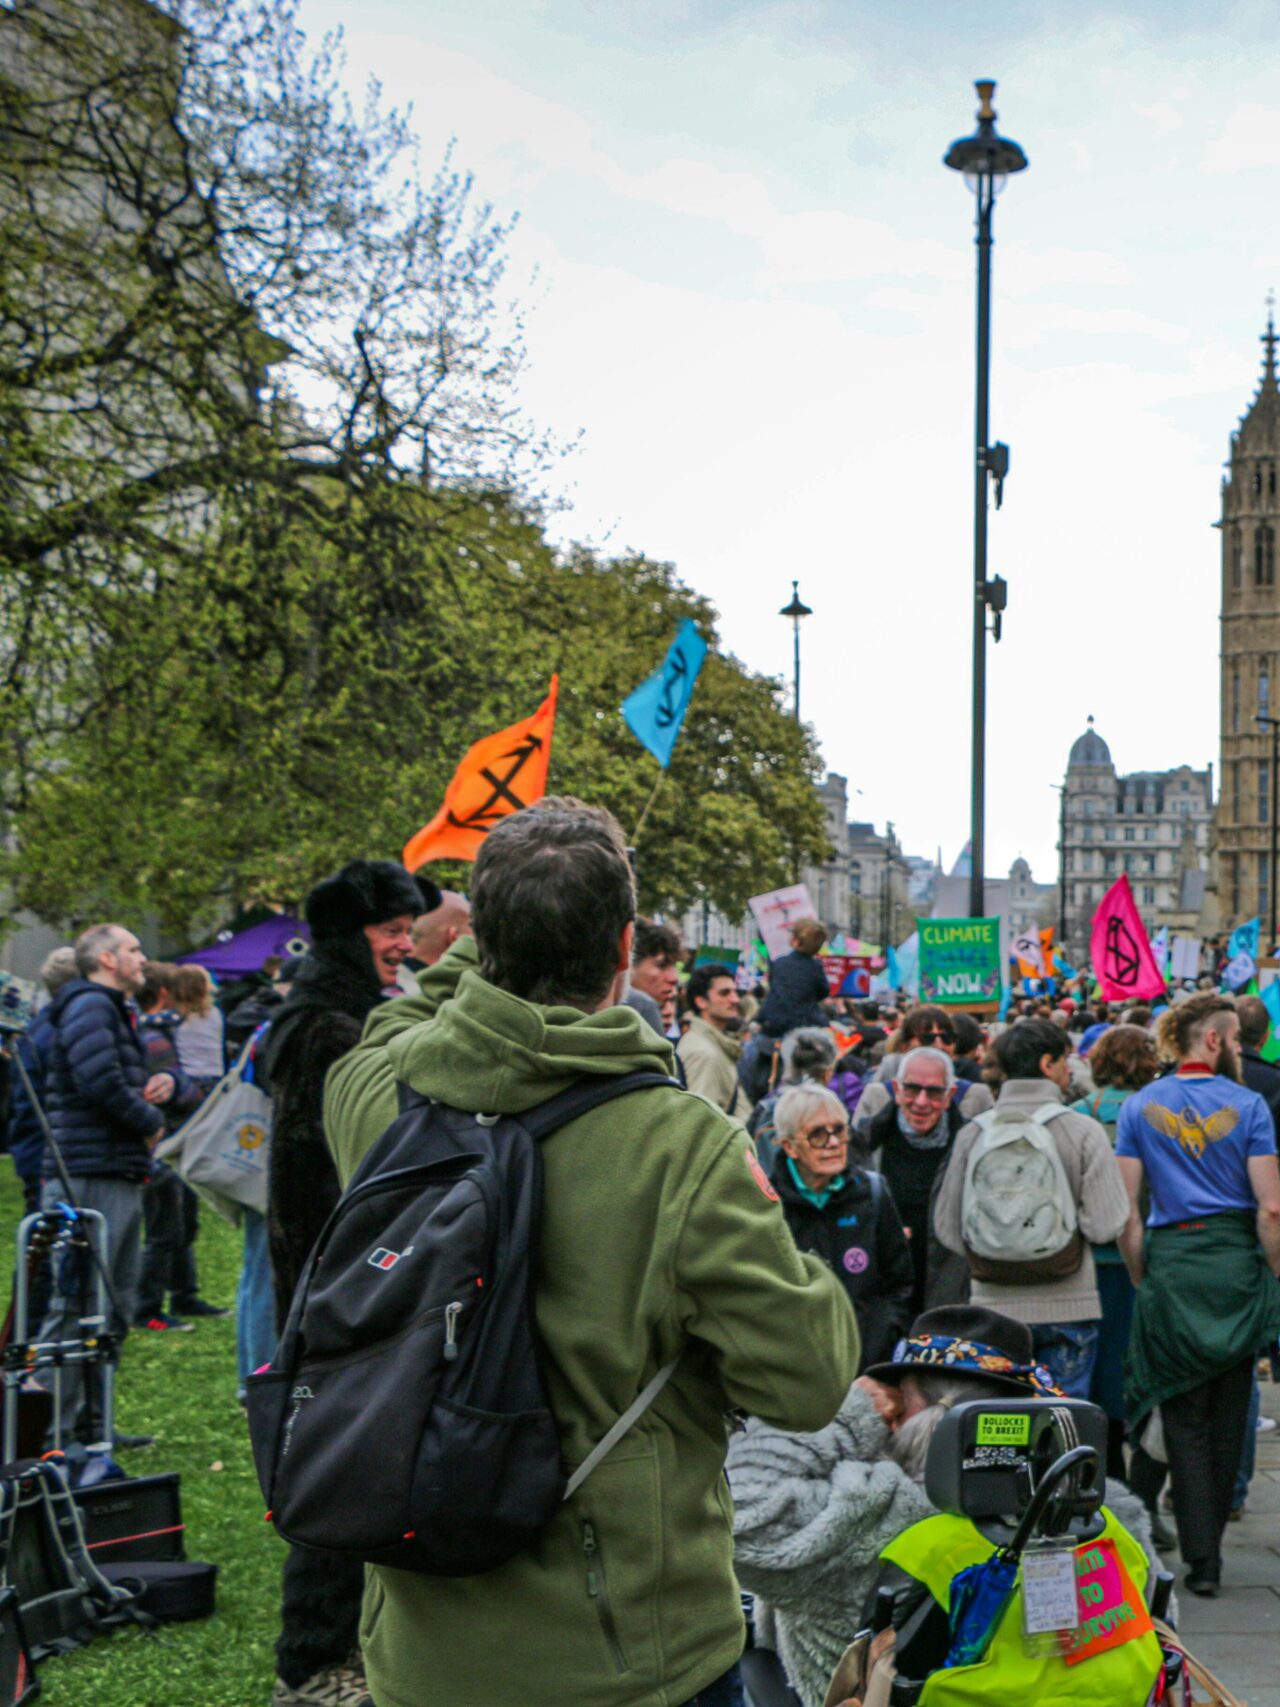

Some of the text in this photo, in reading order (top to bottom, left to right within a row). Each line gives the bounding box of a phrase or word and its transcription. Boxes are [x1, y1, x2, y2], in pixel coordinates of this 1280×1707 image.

[924, 925, 992, 944] CLIMATE
[937, 972, 982, 996] NOW
[982, 1427, 1024, 1435] TO BREXIT
[984, 1418, 1024, 1426] BOLLOCKS
[1080, 1582, 1104, 1608] TO
